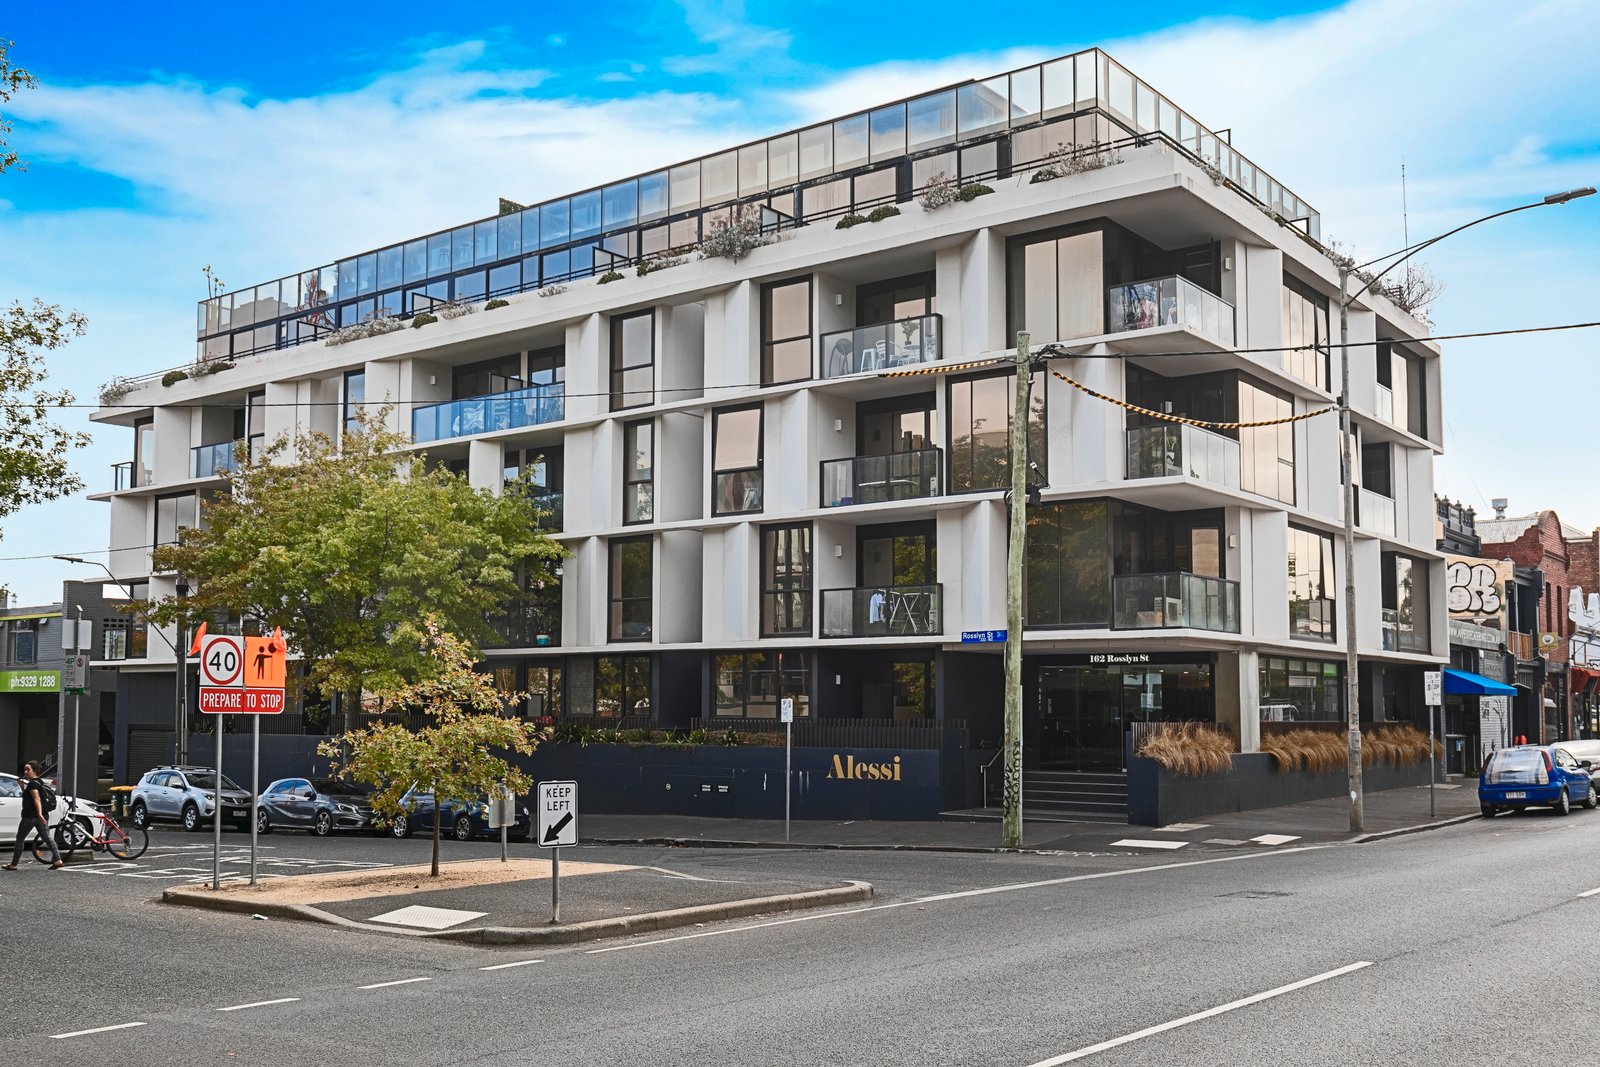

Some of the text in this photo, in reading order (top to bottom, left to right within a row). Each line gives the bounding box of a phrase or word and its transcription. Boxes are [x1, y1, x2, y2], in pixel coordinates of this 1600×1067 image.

[963, 632, 986, 640] Rosslyn
[986, 631, 994, 639] St
[208, 651, 236, 672] 40
[1090, 653, 1150, 664] 162 Rosslyn St
[39, 675, 56, 687] 1288
[202, 692, 282, 708] PREPARE TO STOP
[825, 754, 901, 781] Alessi
[546, 787, 571, 798] KEEP
[547, 800, 570, 811] LEFT
